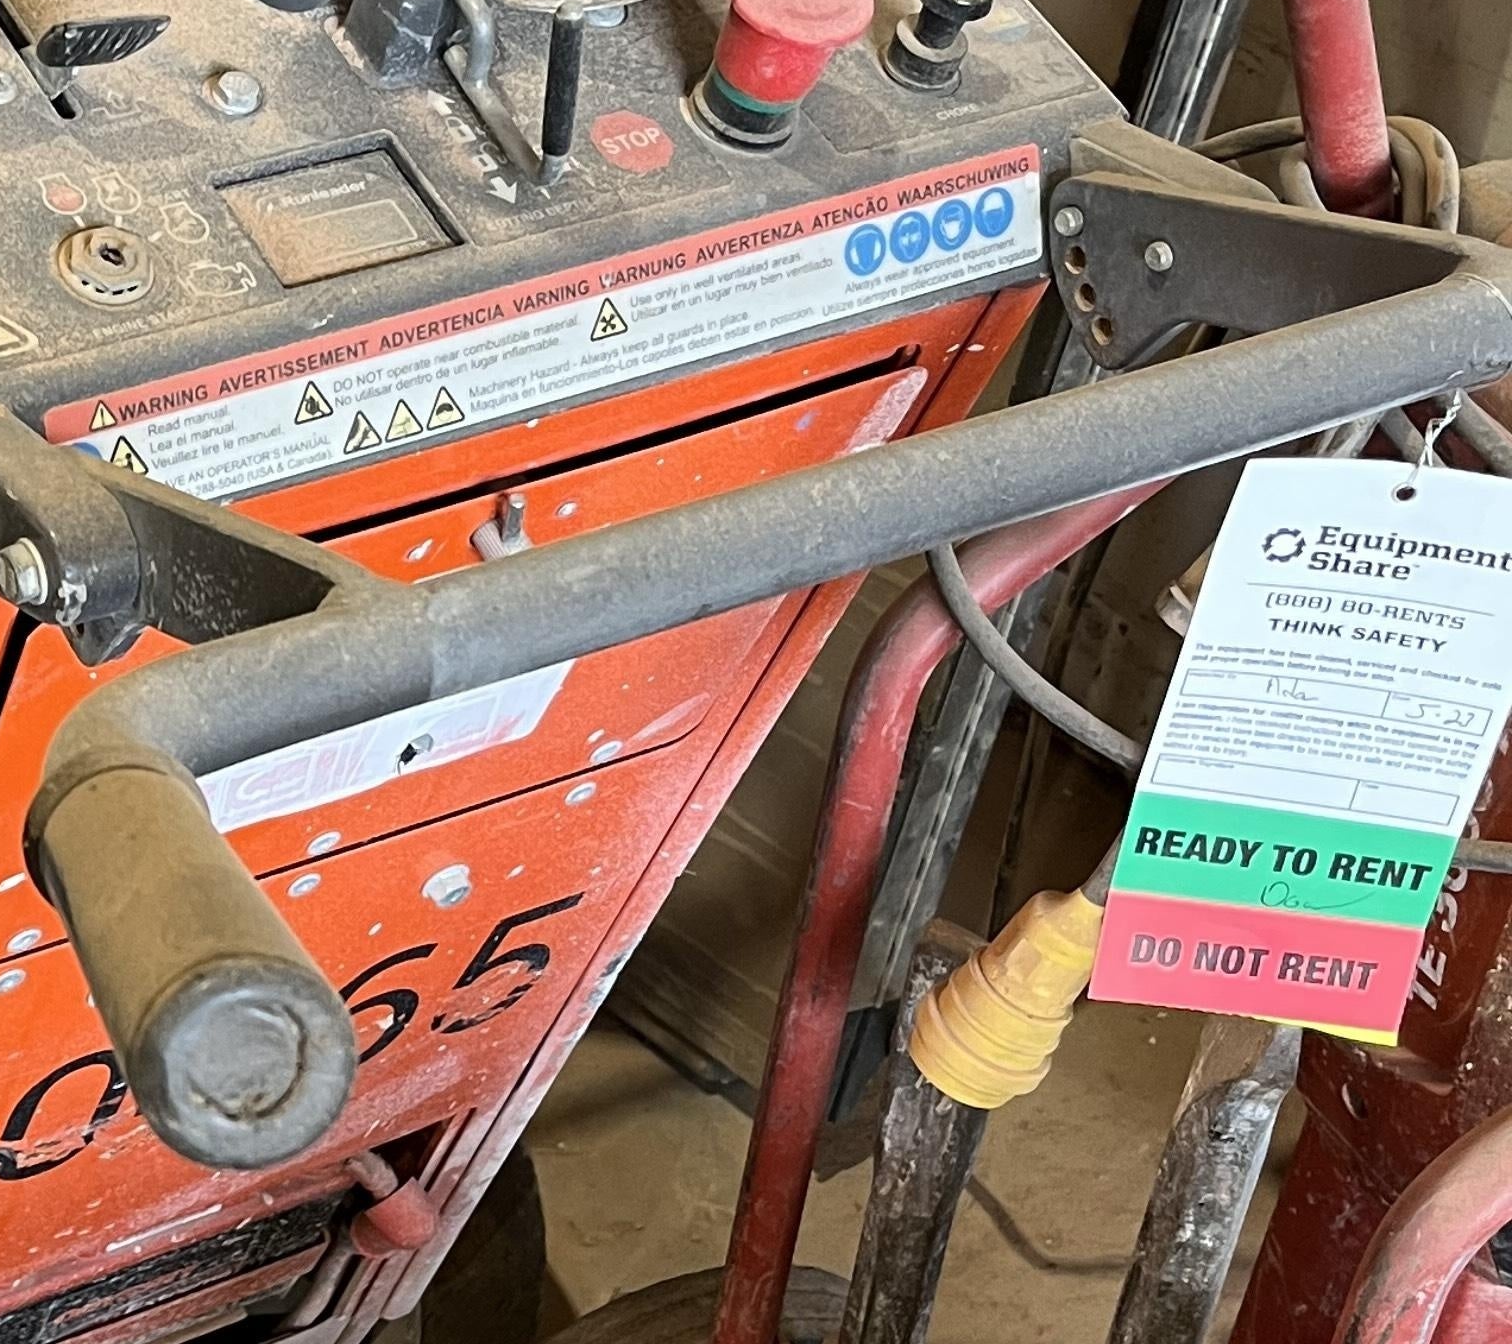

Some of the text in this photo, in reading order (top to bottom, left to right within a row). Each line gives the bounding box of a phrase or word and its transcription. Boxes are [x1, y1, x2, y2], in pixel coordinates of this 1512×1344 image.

[600, 127, 661, 155] STOP
[118, 383, 208, 423] WARNING
[217, 339, 369, 396] AVERTISSEMENT
[378, 302, 504, 351] ADVERTENCIA
[513, 278, 590, 314] VARNING
[695, 219, 803, 263] AVVERTENZA
[896, 156, 1029, 207] WAARSCHUWING
[654, 285, 677, 303] only
[680, 281, 690, 293] in
[692, 274, 714, 290] well
[333, 376, 354, 394] DO
[355, 368, 383, 387] NOT
[386, 356, 430, 380] operate
[439, 348, 458, 364] near
[468, 371, 527, 400] Machinery
[529, 359, 570, 381] Hazard
[580, 345, 619, 367] Always
[622, 336, 648, 357] keep
[706, 317, 717, 331] in
[334, 392, 352, 408] No
[395, 370, 432, 391] dentro
[435, 365, 449, 379] de
[453, 361, 467, 375] un
[470, 351, 499, 372] lugar
[522, 385, 536, 398] en
[147, 417, 180, 437] Read
[149, 437, 172, 455] Lea
[175, 433, 186, 447] el
[151, 446, 198, 470] Veuillez
[201, 440, 219, 456] lire
[222, 436, 234, 450] le
[187, 468, 205, 484] AN
[206, 447, 281, 478] OPERATOR'S
[283, 433, 329, 457] MANUAL
[1306, 549, 1414, 582] Share
[1313, 523, 1512, 573] Equipment
[1263, 589, 1468, 630] (888) 80-RENTS
[1265, 614, 1448, 653] THINK SAFETY
[1133, 825, 1433, 892] READY TO RENT
[1127, 932, 1379, 992] DO NOT RENT
